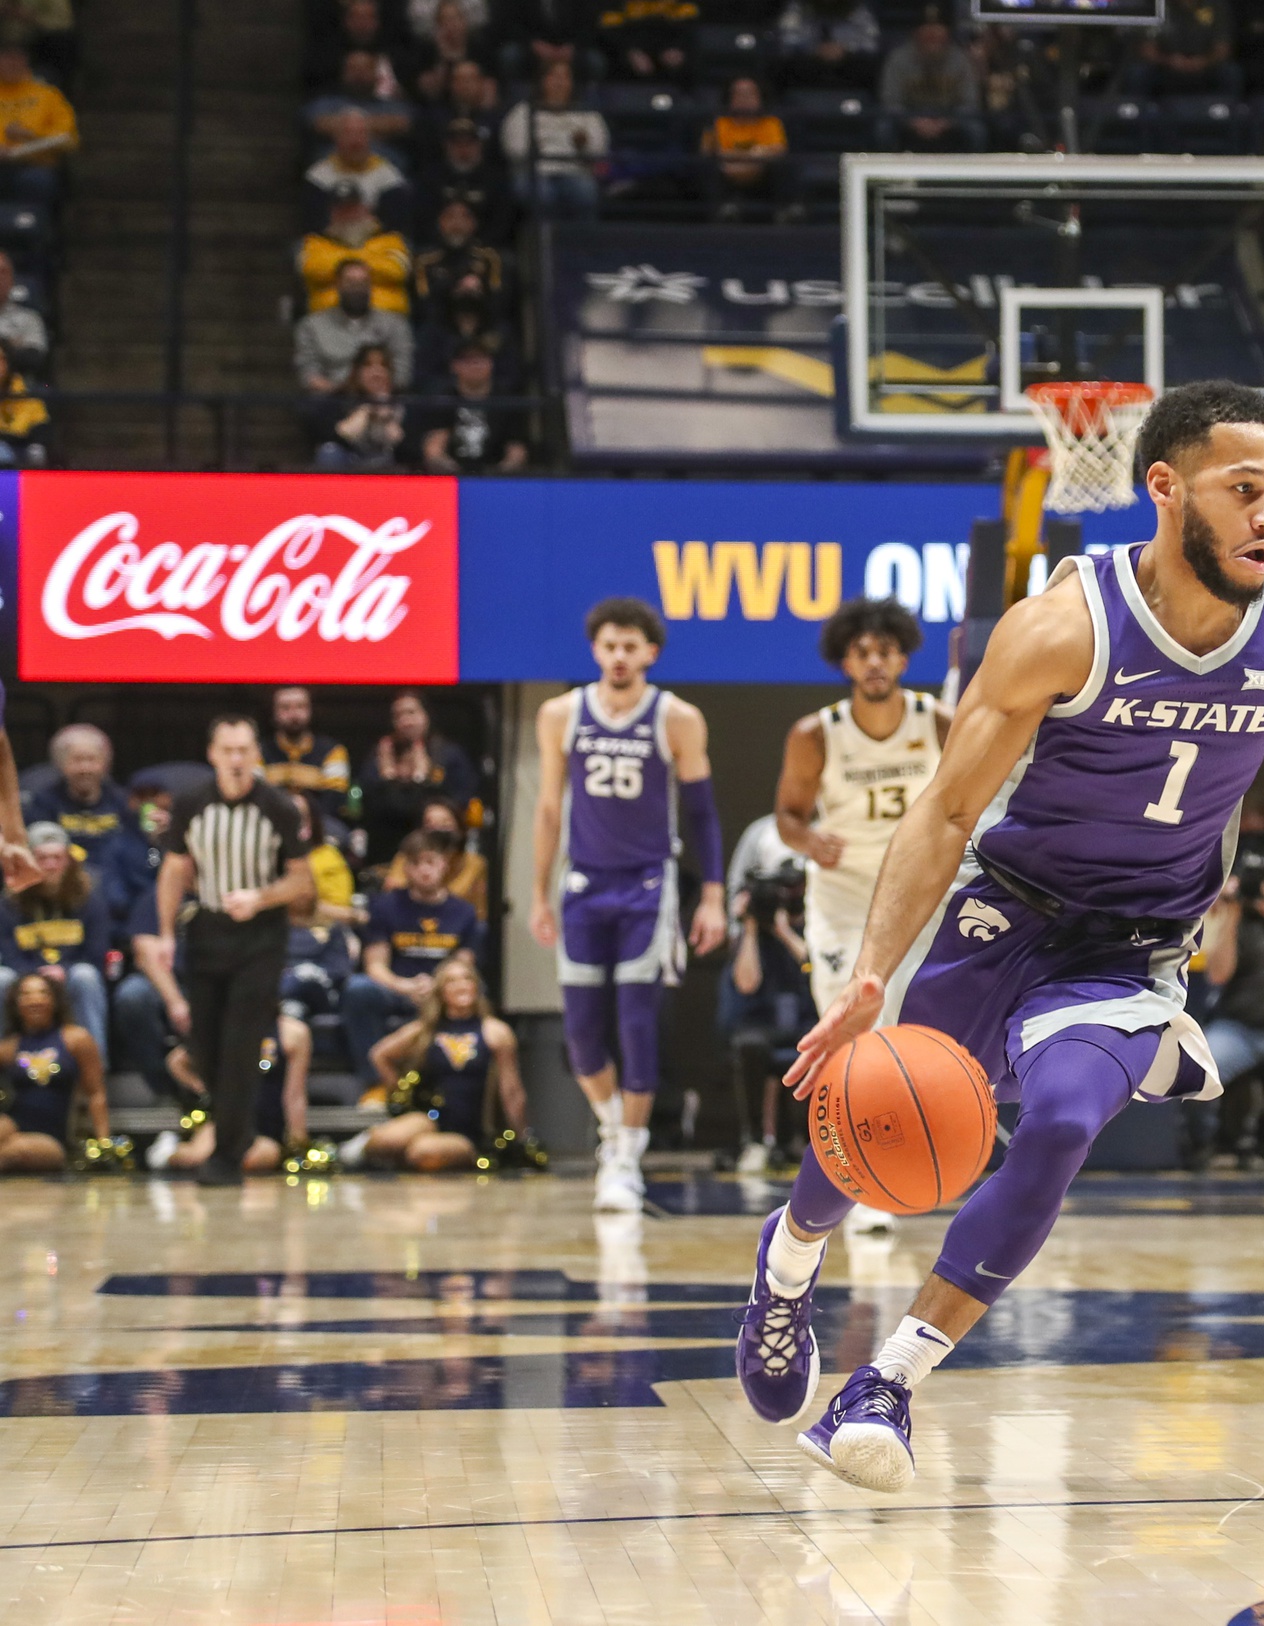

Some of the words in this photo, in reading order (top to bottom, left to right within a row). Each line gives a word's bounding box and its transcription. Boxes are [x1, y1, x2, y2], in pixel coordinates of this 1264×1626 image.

[41, 511, 433, 642] Coca-Cola
[653, 541, 842, 621] WVU
[584, 754, 643, 799] 25
[868, 786, 906, 820] 13
[1143, 740, 1199, 825] 1
